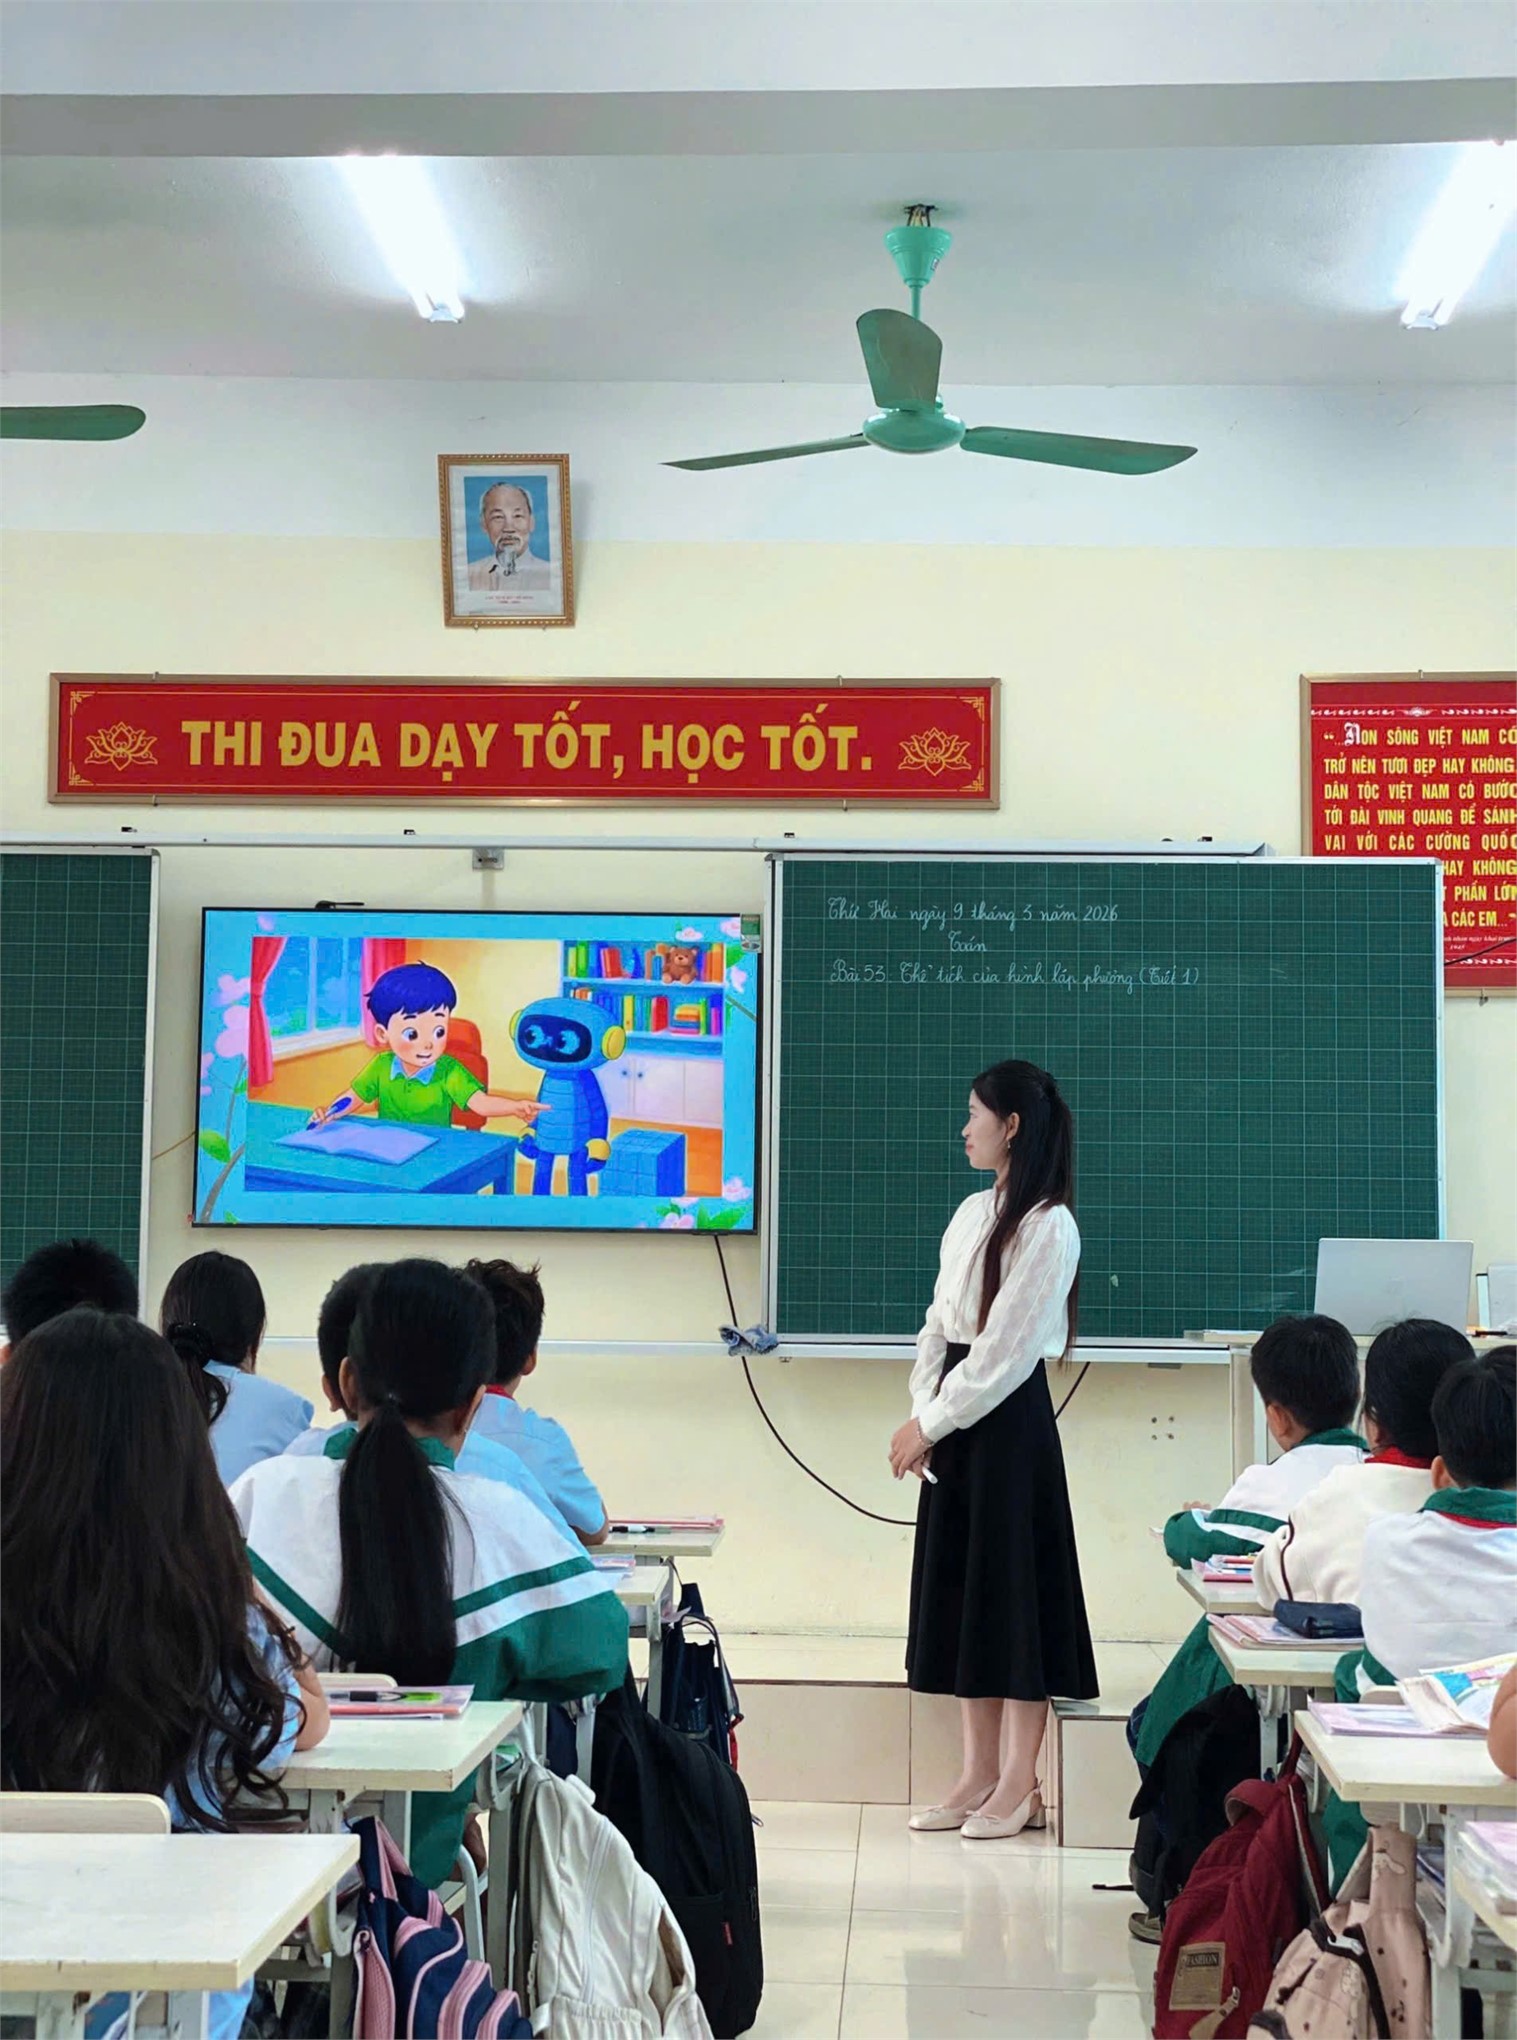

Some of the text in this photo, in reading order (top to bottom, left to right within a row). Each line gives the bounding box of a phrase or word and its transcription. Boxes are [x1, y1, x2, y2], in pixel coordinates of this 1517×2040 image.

[181, 701, 872, 784] THI ĐUA DẠY TỐT, HỌC TỐT.
[1387, 726, 1419, 746] SÔNG
[1428, 725, 1453, 749] VIỆT
[1462, 728, 1489, 746] NAM
[1499, 725, 1517, 745] CÓ
[1324, 751, 1347, 775] TRỞ
[1352, 755, 1376, 775] NÊN
[1382, 757, 1408, 775] TƯƠI
[1413, 758, 1437, 778] ĐẸP
[1442, 758, 1466, 774] HAY
[1324, 780, 1348, 800] DÂN
[1357, 780, 1379, 803] TỘC
[1388, 780, 1413, 803] VIỆT
[1422, 783, 1450, 800] NAM
[1459, 780, 1475, 799] CÓ
[1324, 804, 1343, 826] TỚI
[1350, 805, 1370, 826] ĐÀI
[1377, 809, 1405, 826] VINH
[1412, 809, 1453, 827] QUANG
[1325, 835, 1346, 851] VAI
[1357, 830, 1378, 851] VỚI
[1389, 832, 1415, 851] CÁC
[1426, 830, 1470, 851] CƯỜNG
[1443, 857, 1517, 876] HAY KHÔNG
[828, 896, 860, 920] Thứ
[868, 899, 898, 920] Hai
[910, 904, 946, 931] ngày
[953, 902, 963, 920] 9
[970, 900, 1016, 932] tháng
[1040, 903, 1078, 921] năm
[1082, 904, 1118, 921] 2026
[1451, 908, 1475, 927] CÁC
[948, 930, 988, 952] Toán
[830, 958, 860, 983] Bài
[936, 965, 963, 984] tích
[973, 966, 1000, 983] của
[1007, 961, 1044, 984] hình
